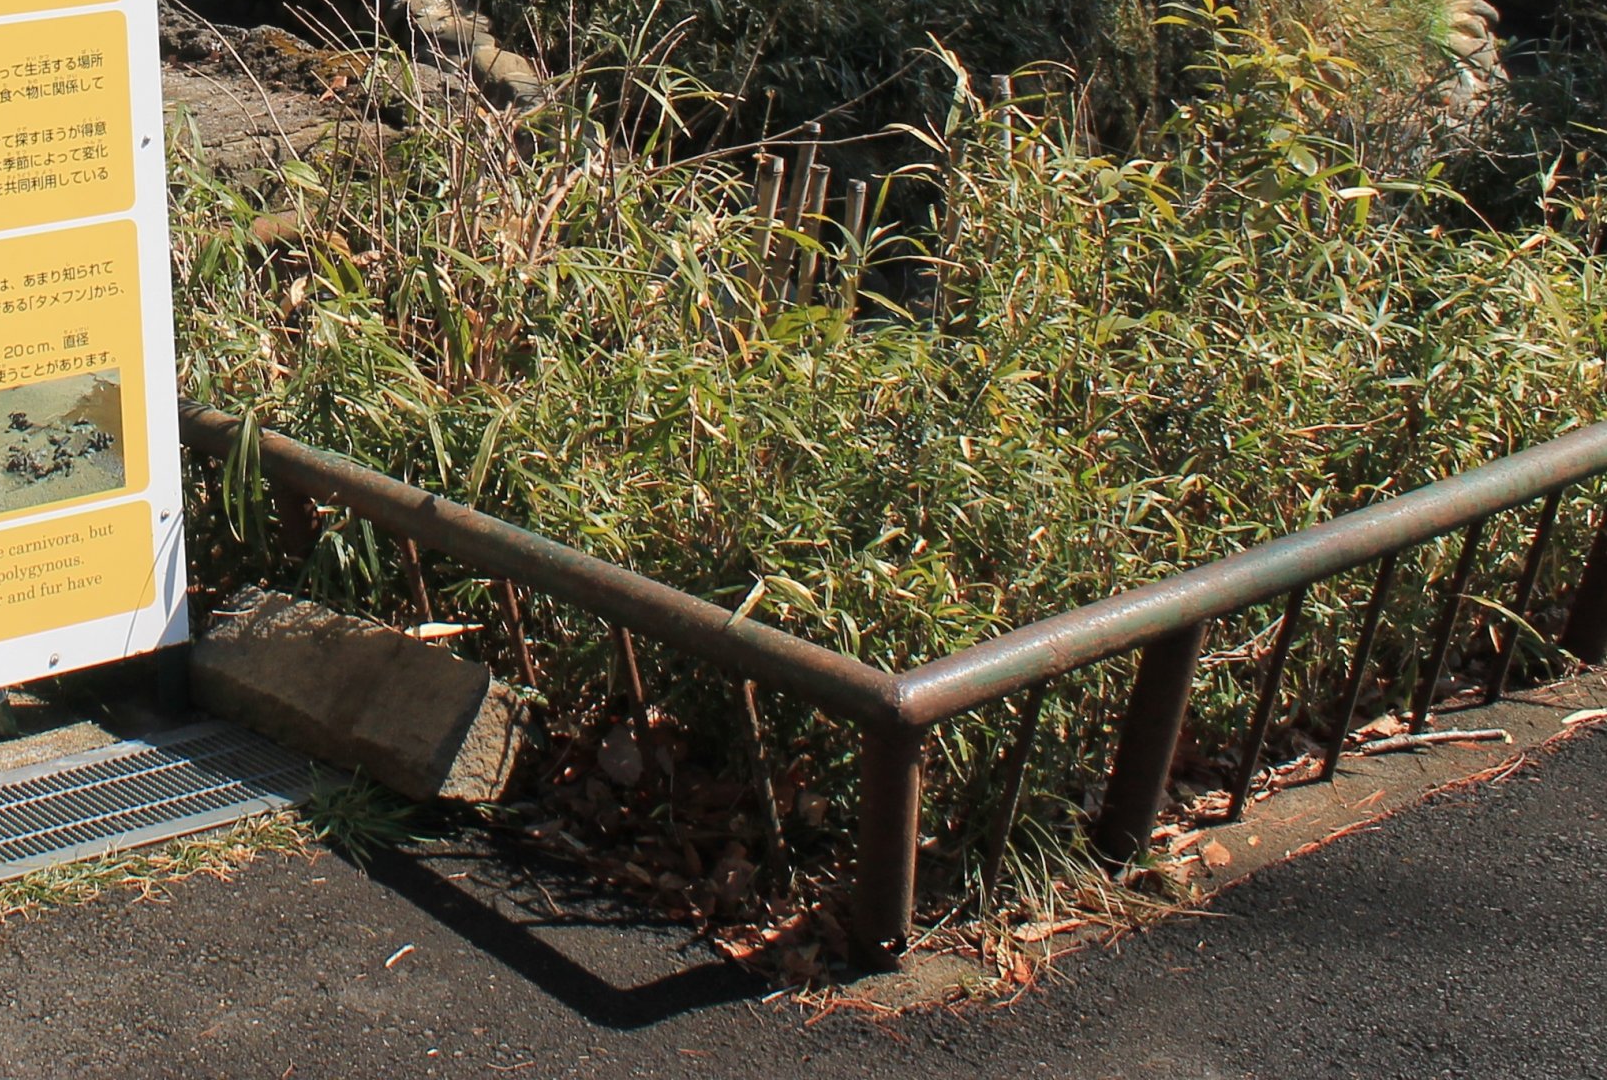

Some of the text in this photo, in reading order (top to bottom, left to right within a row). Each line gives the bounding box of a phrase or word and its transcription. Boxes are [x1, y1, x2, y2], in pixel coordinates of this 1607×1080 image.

[7, 531, 86, 558] carnivora,
[87, 522, 115, 540] but
[6, 583, 37, 605] and
[39, 581, 64, 598] fur
[66, 573, 103, 592] have
